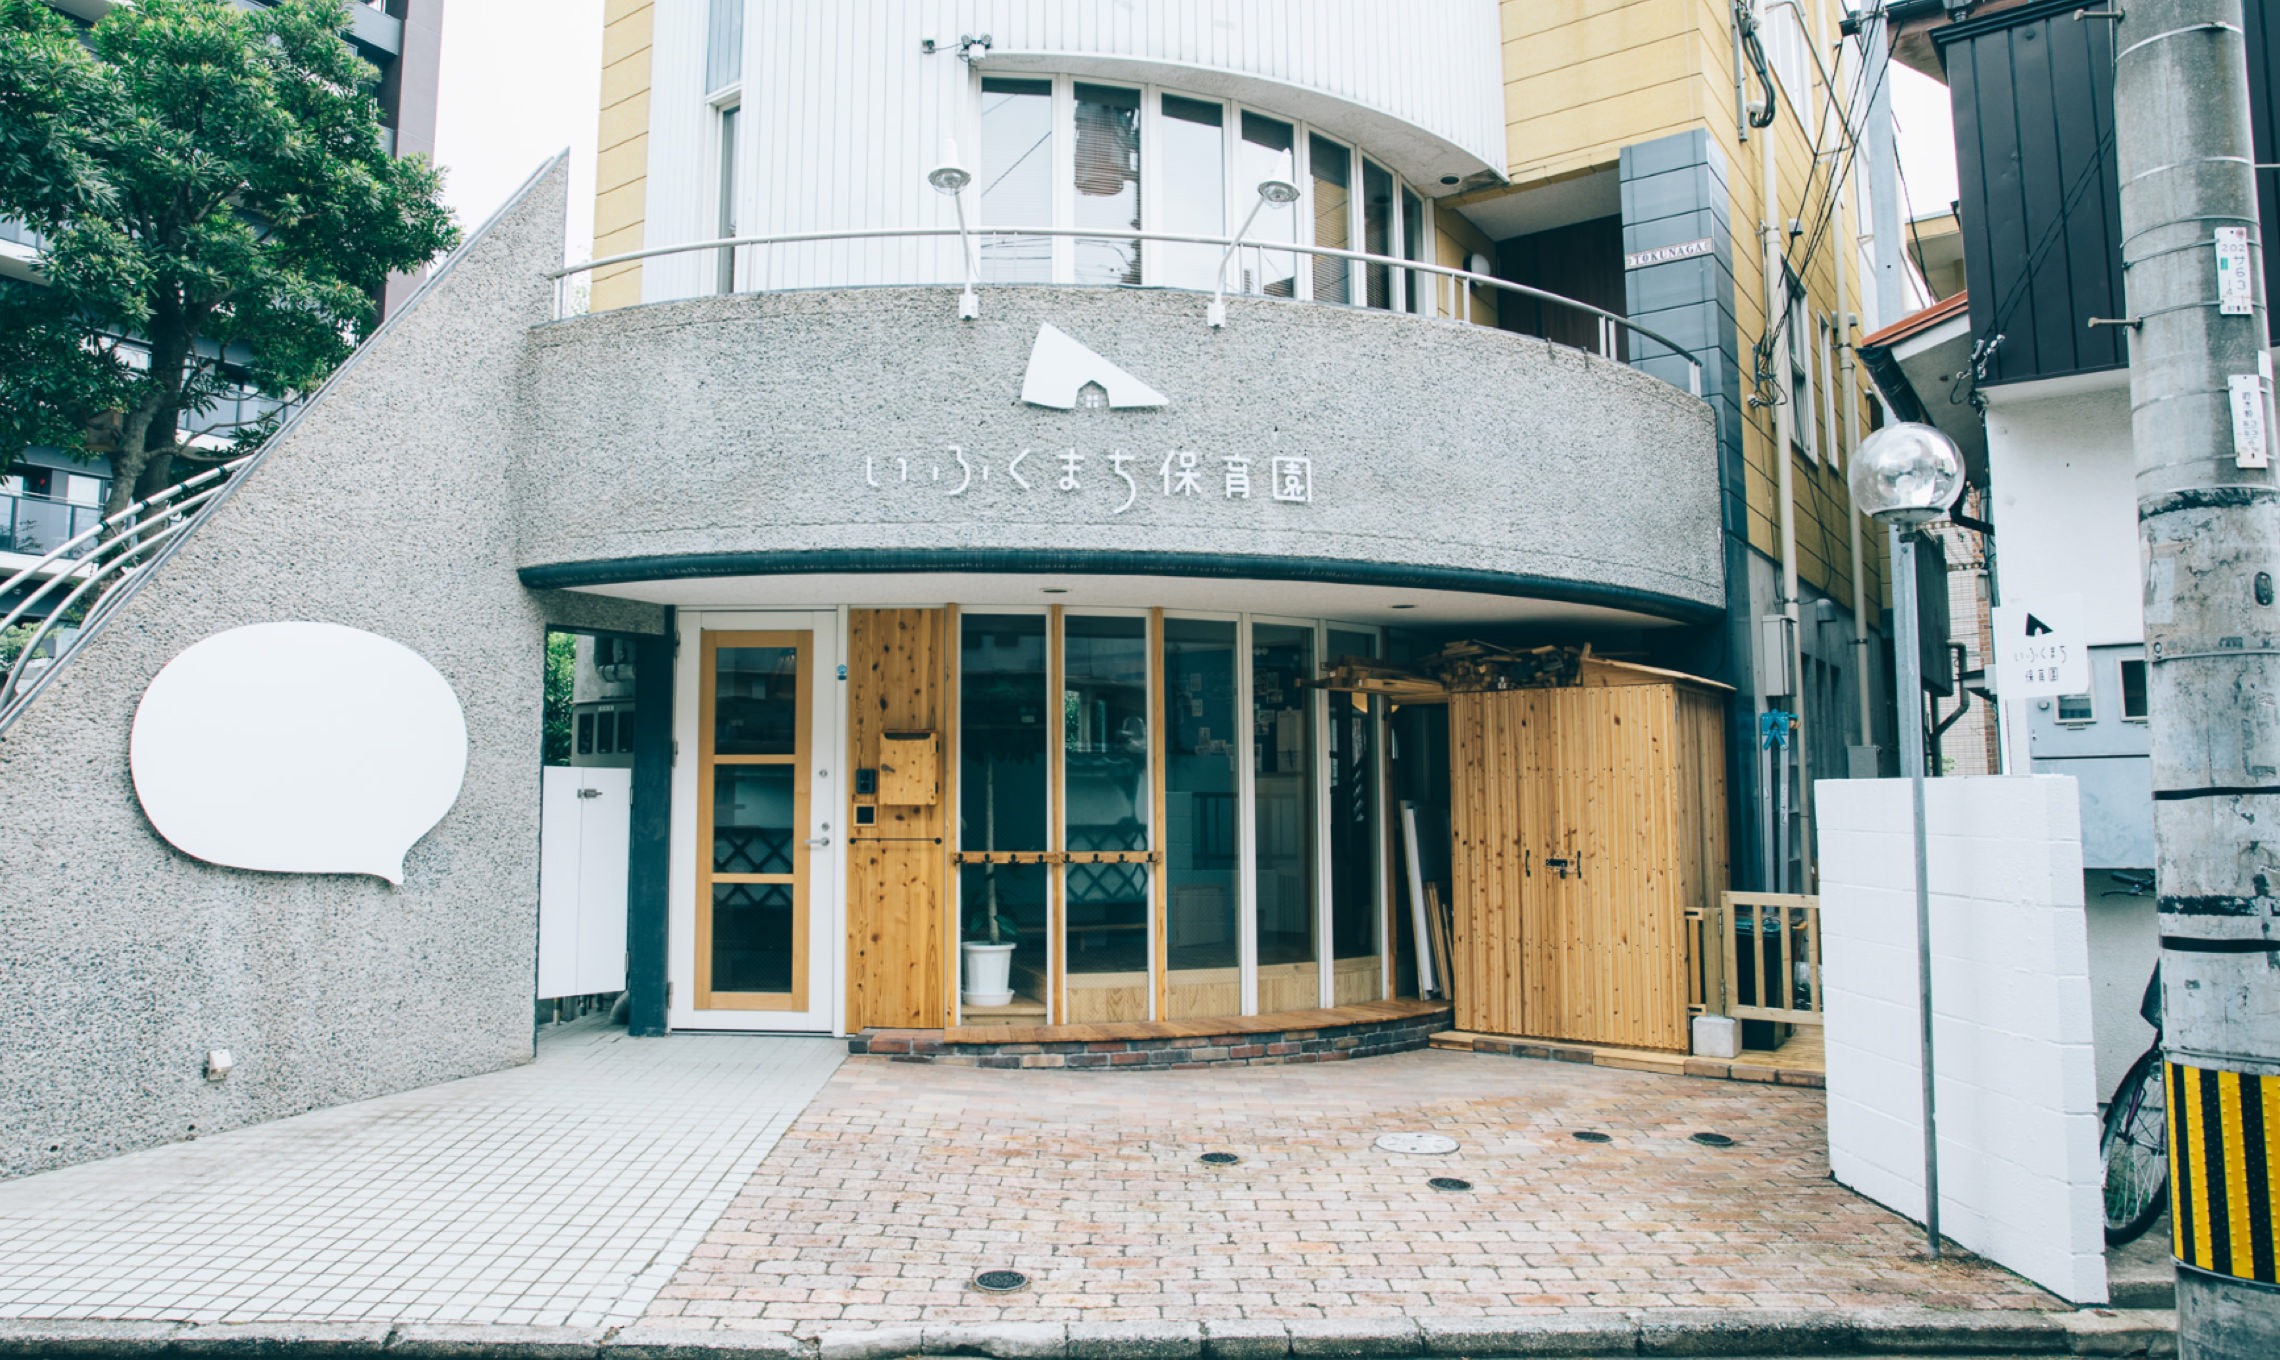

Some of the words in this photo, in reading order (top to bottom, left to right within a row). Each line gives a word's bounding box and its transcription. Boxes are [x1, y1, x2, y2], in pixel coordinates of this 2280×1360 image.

[1634, 242, 1704, 265] TOKUNAGA
[866, 445, 1312, 514] いふくまち保育園
[2014, 645, 2066, 663] いふくまち
